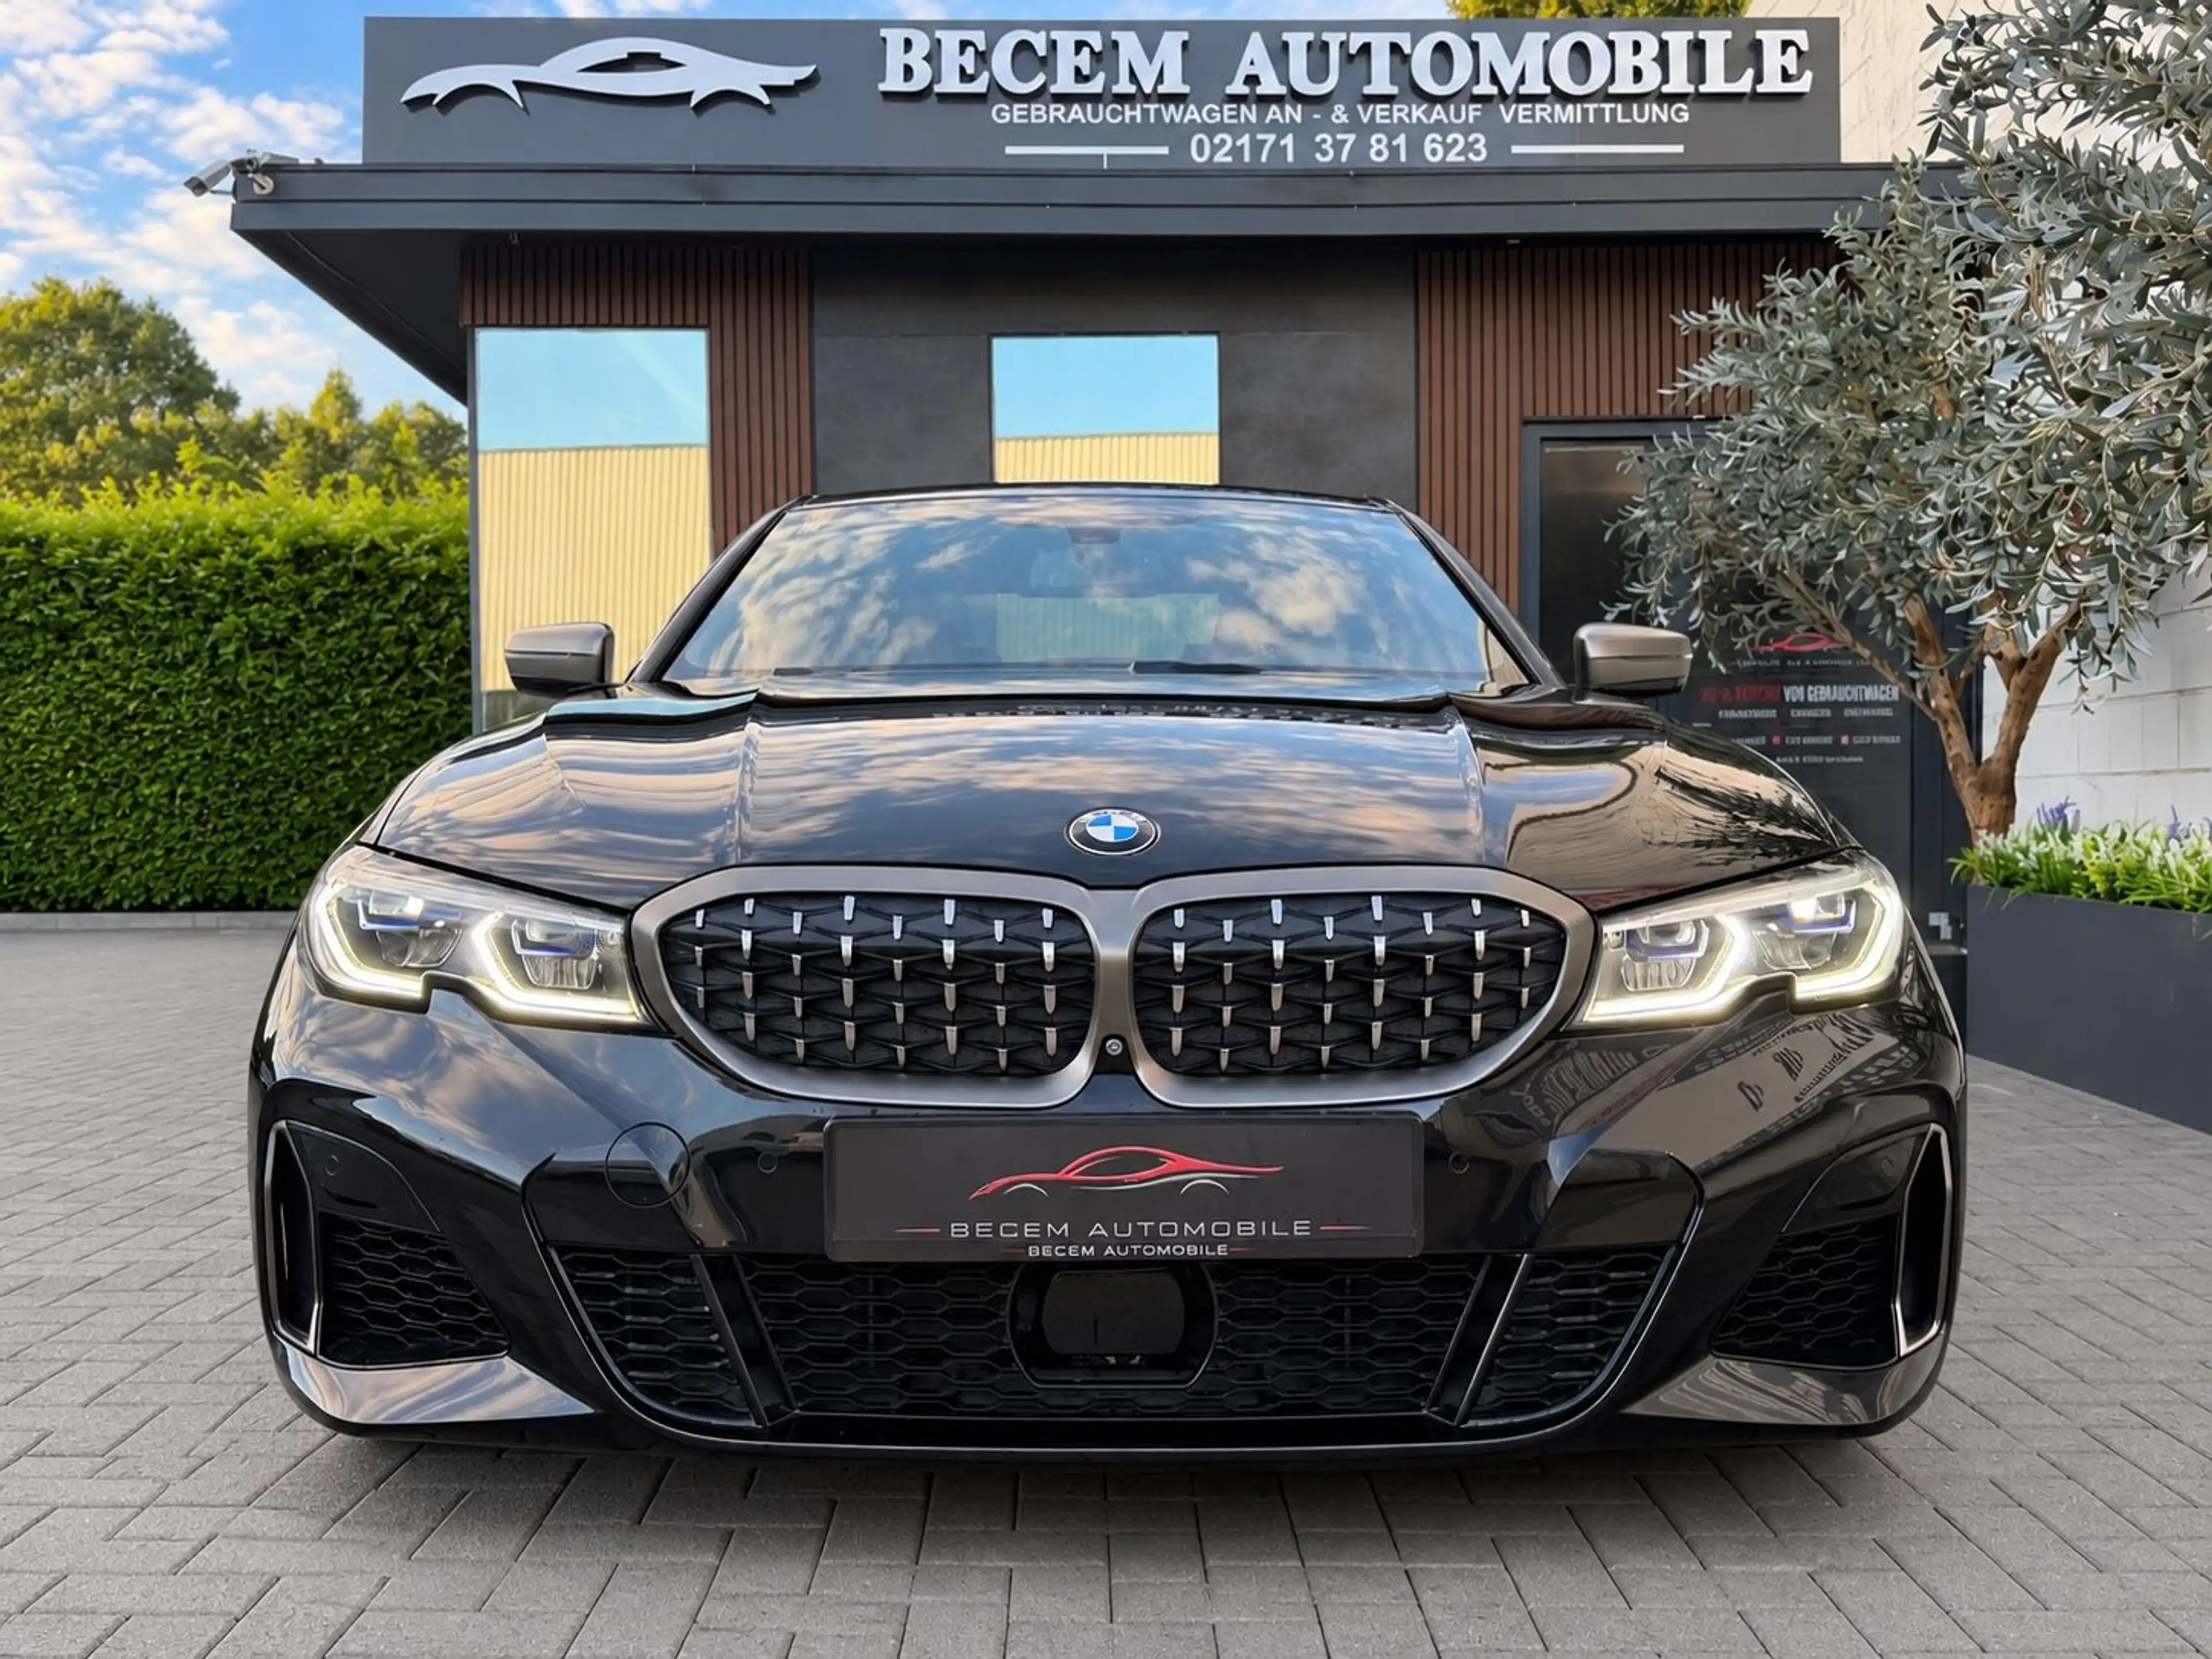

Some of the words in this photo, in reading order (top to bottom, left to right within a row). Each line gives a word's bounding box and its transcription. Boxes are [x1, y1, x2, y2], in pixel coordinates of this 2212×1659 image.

[878, 28, 1191, 94] BECEM
[1225, 29, 1813, 96] AUTOMOBILE
[991, 104, 1256, 124] GEBRAUCHTWAGEN
[1264, 104, 1302, 124] AN
[1331, 104, 1350, 124] &
[1361, 104, 1482, 124] VERKAUF
[1499, 103, 1690, 124] VERMITTLUNG
[1190, 132, 1294, 163] 02171
[1314, 132, 1357, 163] 37
[1369, 132, 1407, 162] 81
[1423, 132, 1488, 163] 623
[950, 1222, 1069, 1238] BECEM
[1088, 1220, 1310, 1238] AUTOMOBILE
[1028, 1245, 1095, 1257] BECEM
[1103, 1243, 1229, 1257] AUTOMOBILE
